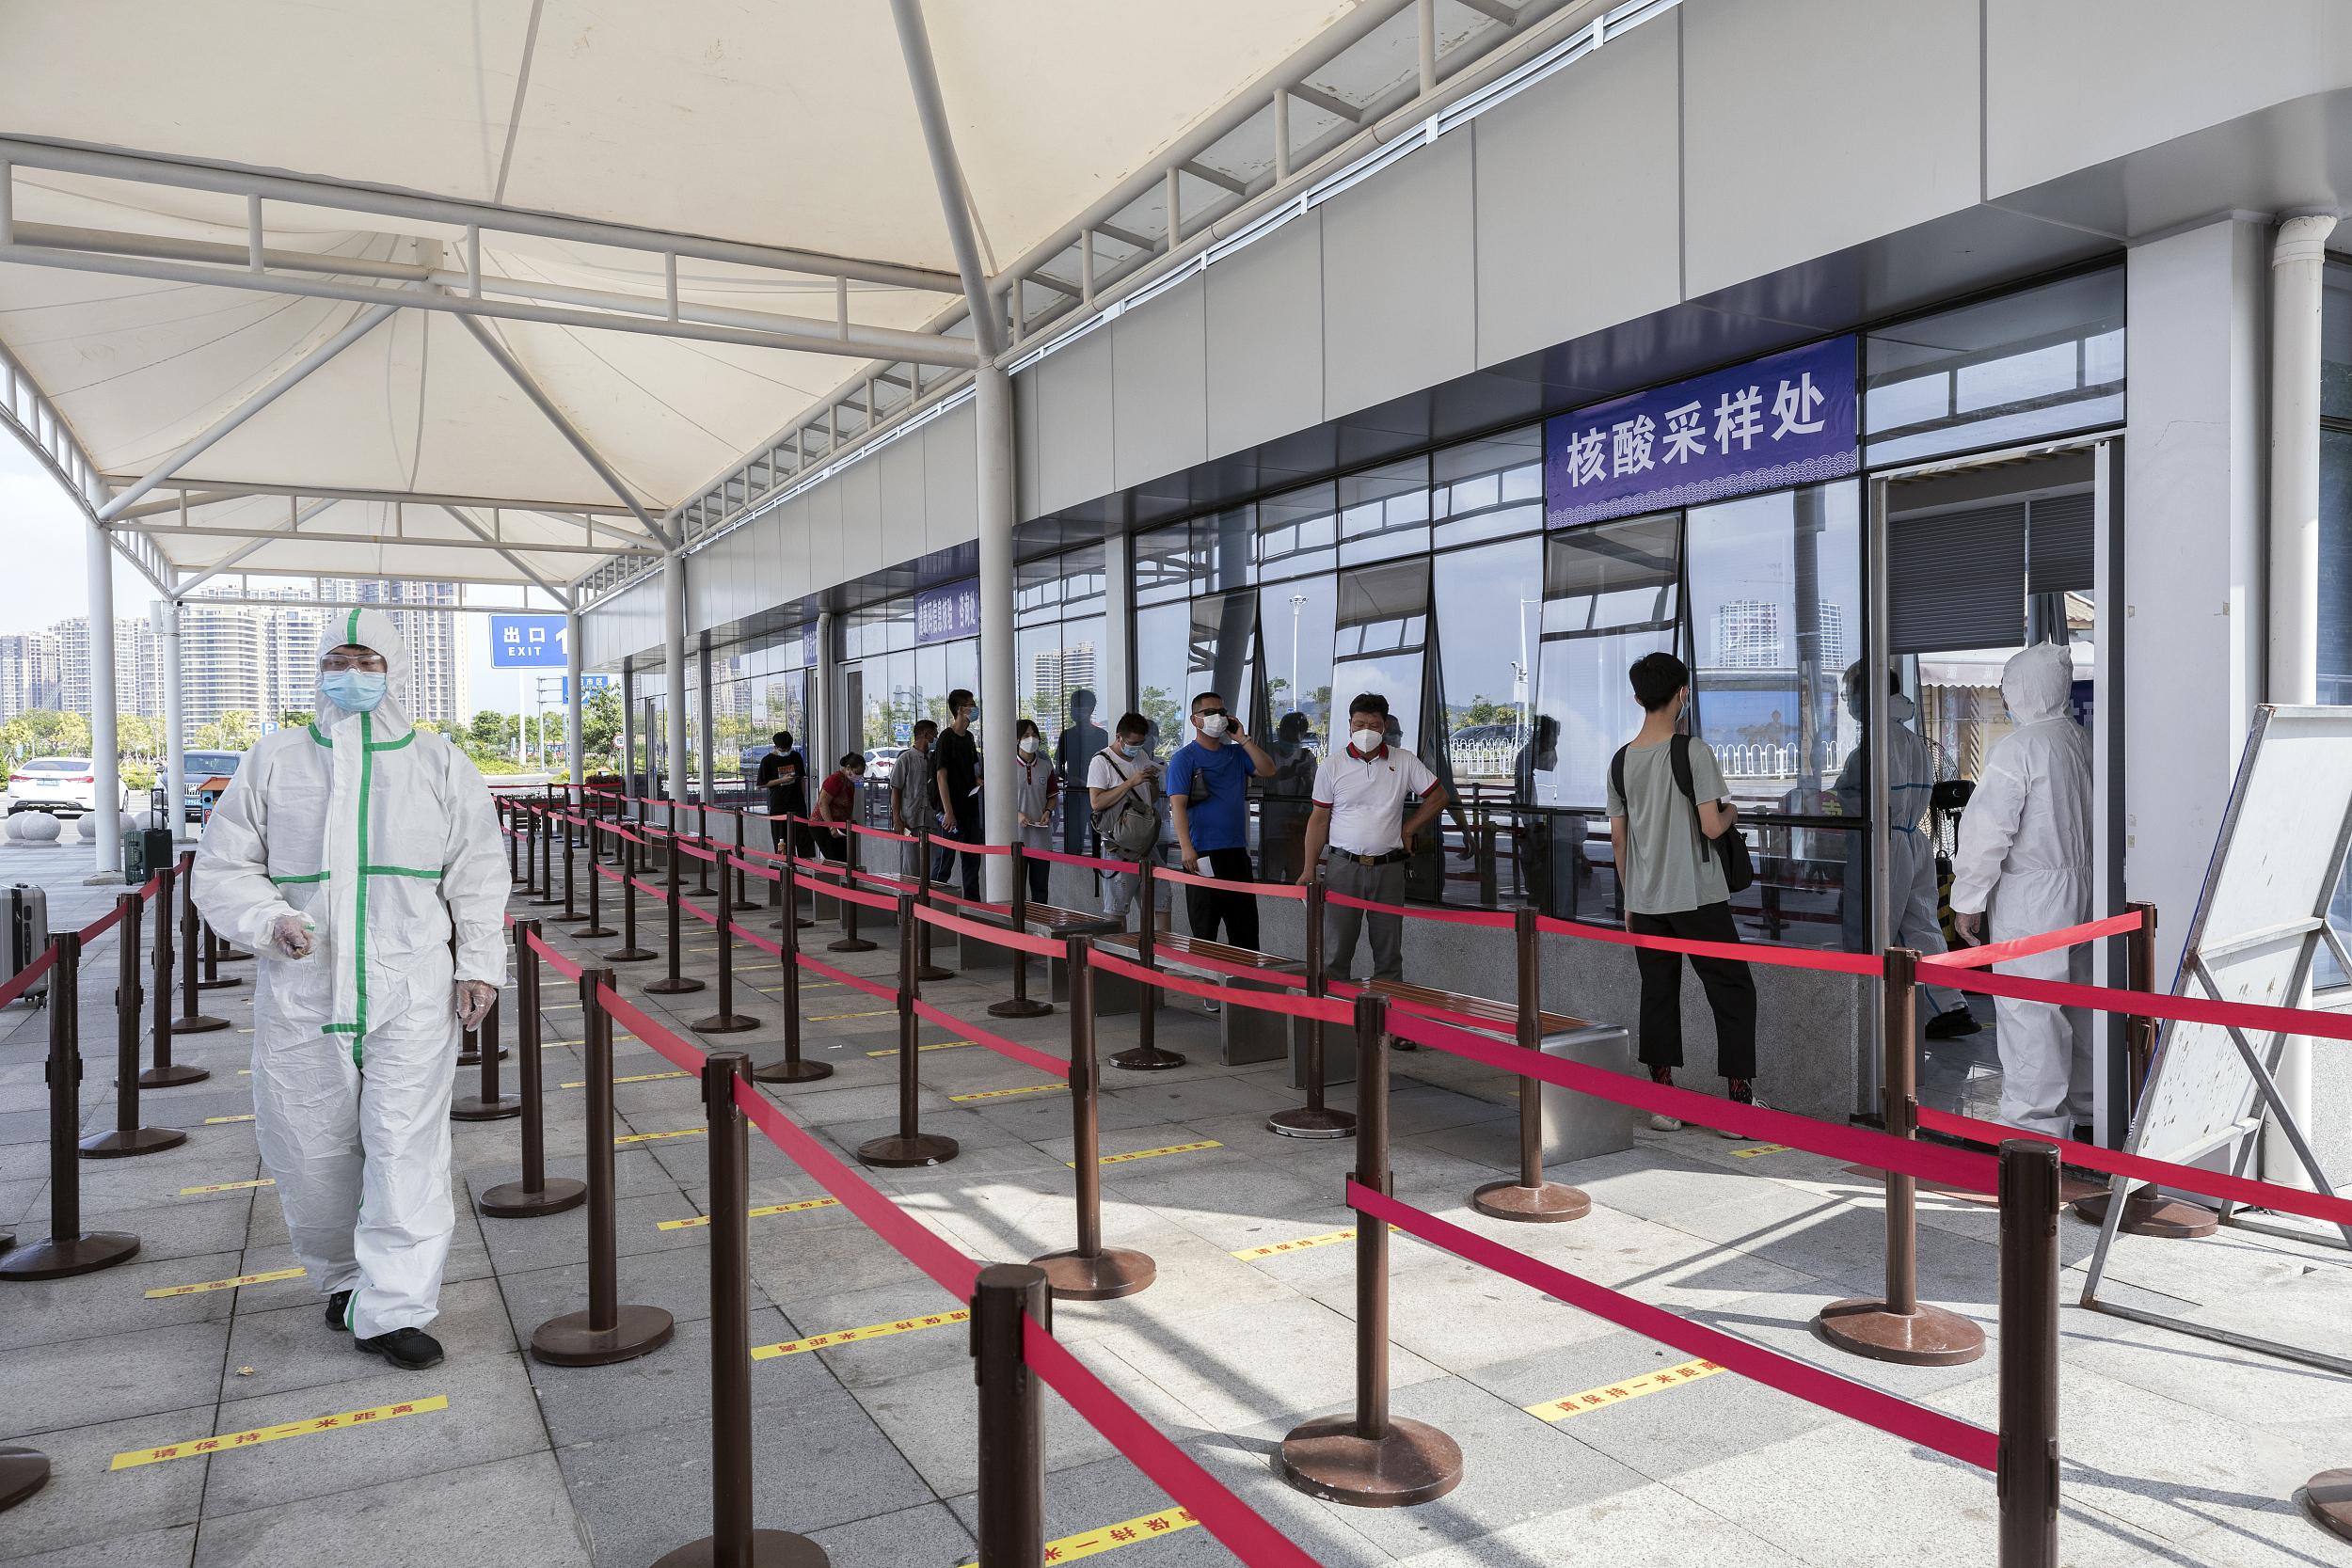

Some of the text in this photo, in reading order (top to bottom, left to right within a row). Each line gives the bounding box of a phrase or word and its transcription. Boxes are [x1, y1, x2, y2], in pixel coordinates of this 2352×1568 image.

[1566, 372, 1825, 488] 核酸采样处
[503, 626, 546, 643] 出口
[508, 646, 542, 657] EXIT
[264, 723, 275, 736] P
[778, 1312, 969, 1353] 请保持一米距离
[152, 1403, 414, 1460] 请保持一米距离
